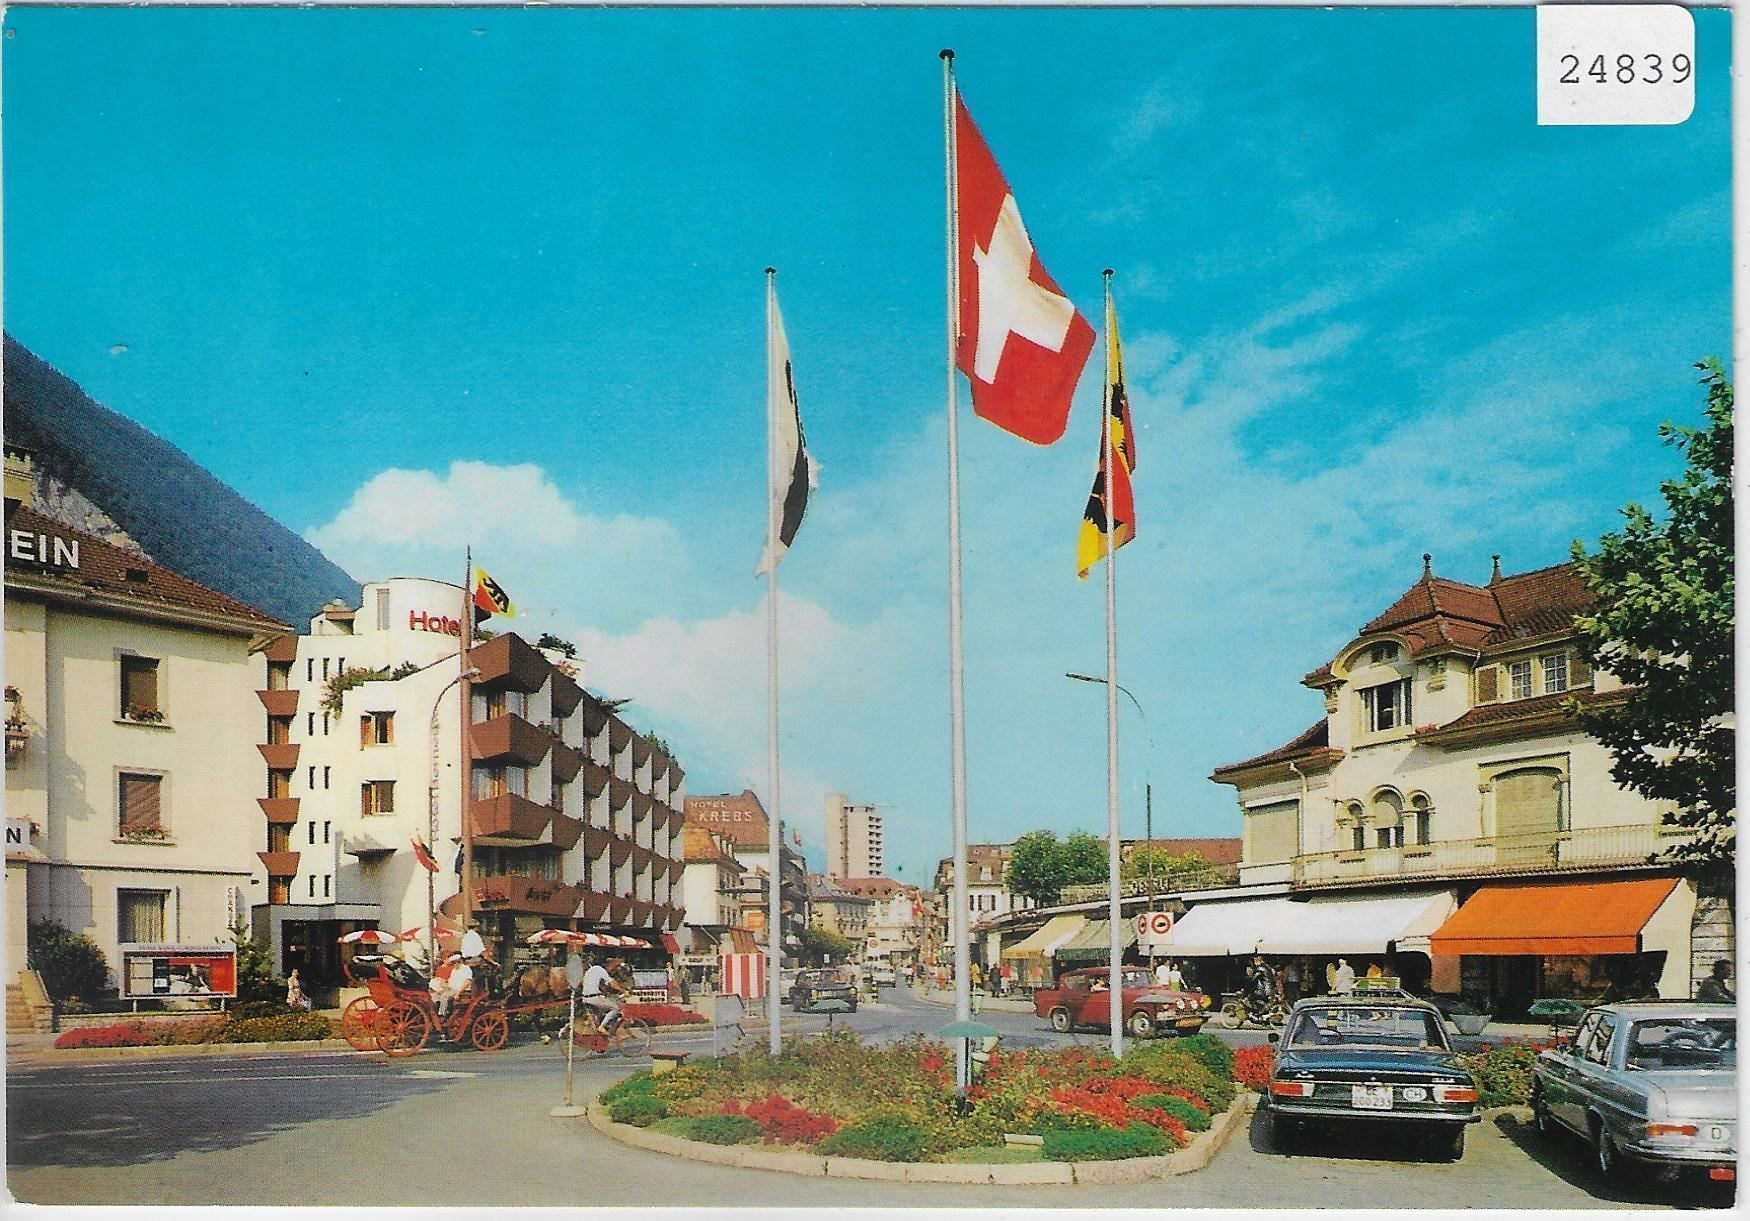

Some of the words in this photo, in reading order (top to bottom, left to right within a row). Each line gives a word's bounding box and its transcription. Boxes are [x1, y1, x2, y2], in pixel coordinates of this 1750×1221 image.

[10, 529, 80, 569] EIN
[409, 609, 461, 637] Hote
[690, 800, 728, 809] HOTEL
[699, 810, 753, 822] KREBS
[1405, 1089, 1423, 1099] CH
[1711, 1127, 1721, 1140] D
